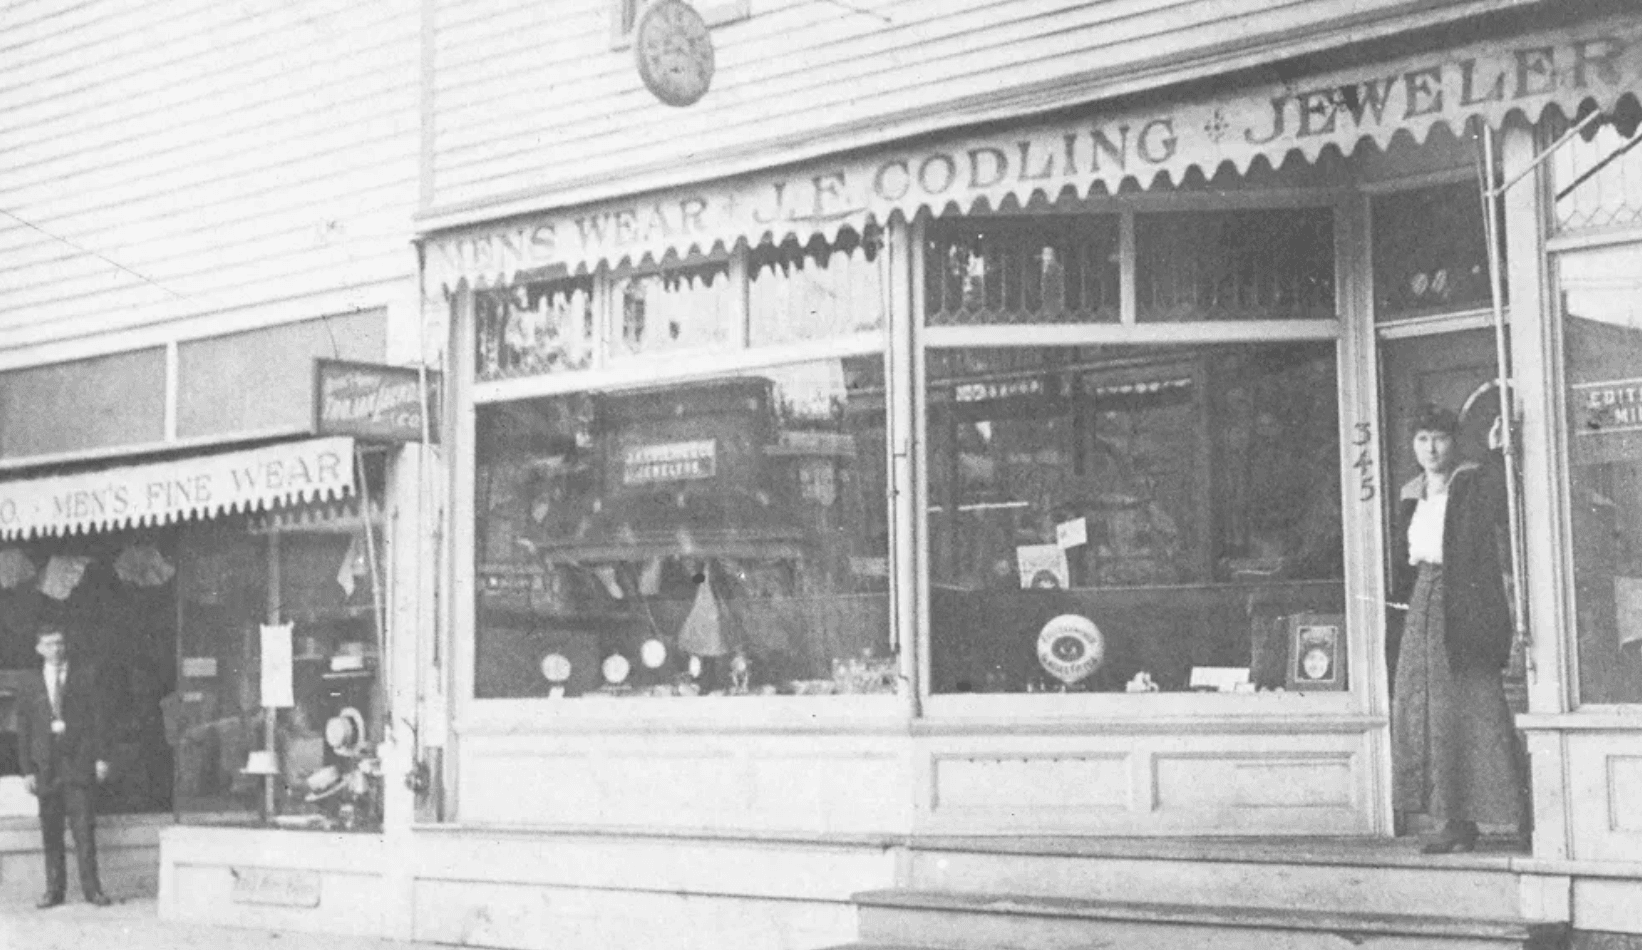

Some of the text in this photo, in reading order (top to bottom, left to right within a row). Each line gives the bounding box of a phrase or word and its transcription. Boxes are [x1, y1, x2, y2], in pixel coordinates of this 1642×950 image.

[575, 200, 709, 247] WEAR
[875, 119, 1178, 199] CODLING
[1245, 38, 1628, 144] JEWELER
[146, 474, 213, 510] FINE
[231, 451, 341, 492] WEAR
[1352, 421, 1376, 502] 345
